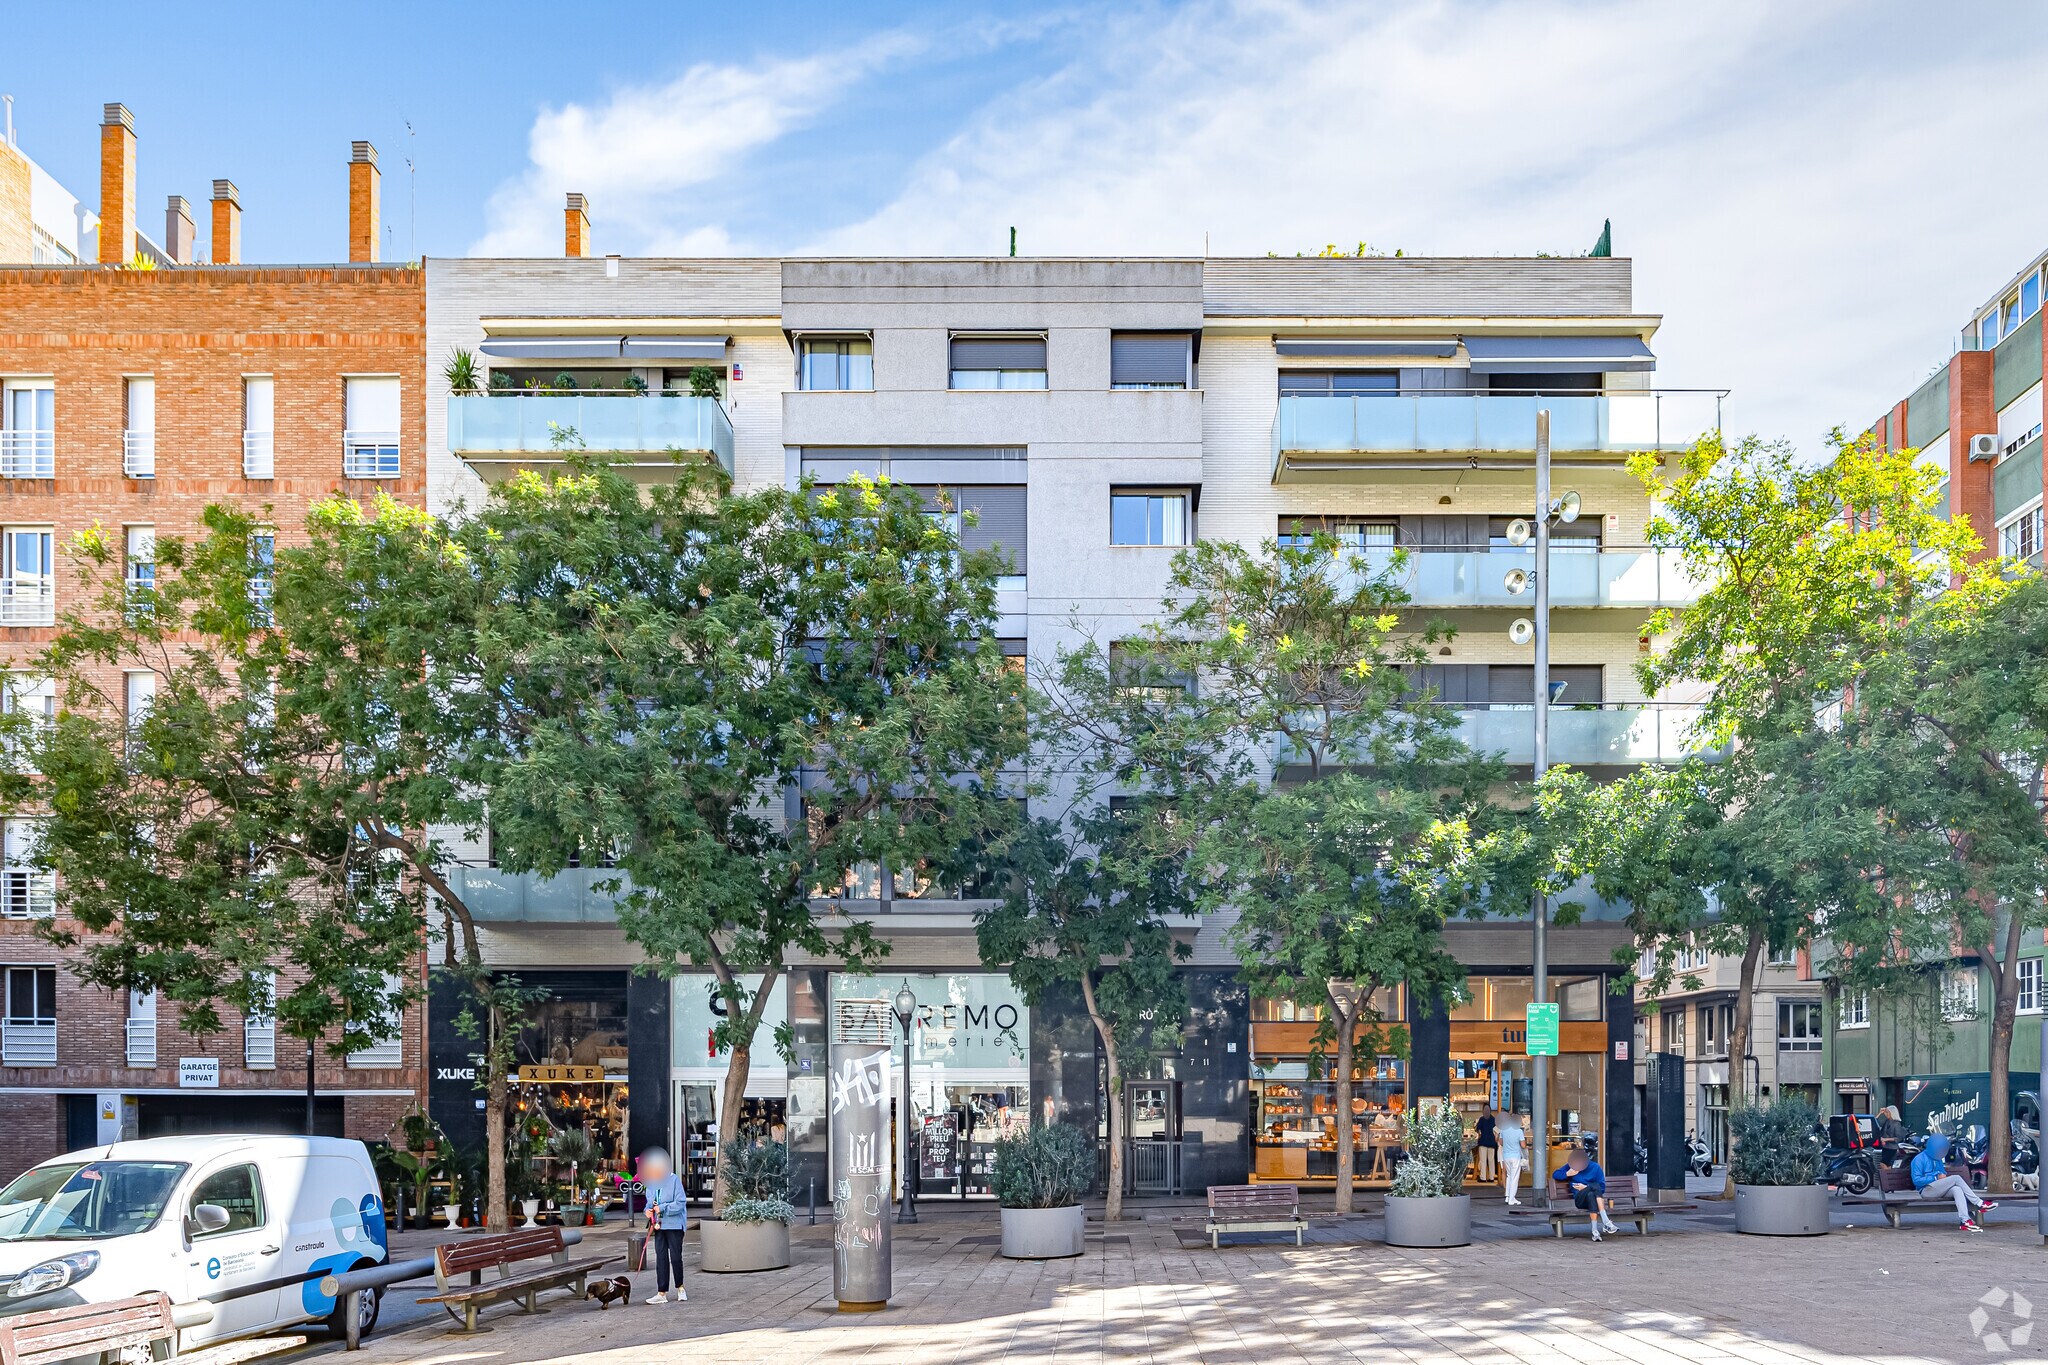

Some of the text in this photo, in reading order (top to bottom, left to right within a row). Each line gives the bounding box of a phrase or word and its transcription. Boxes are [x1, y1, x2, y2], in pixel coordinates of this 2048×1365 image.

[1190, 1058, 1195, 1066] 7
[180, 1063, 218, 1071] GARATGE
[437, 1068, 475, 1080] XUKE
[529, 1068, 594, 1079] XUKE
[925, 1128, 953, 1136] MILLOR
[930, 1135, 949, 1143] PREU
[929, 1148, 950, 1156] PROP
[933, 1155, 946, 1163] TEU
